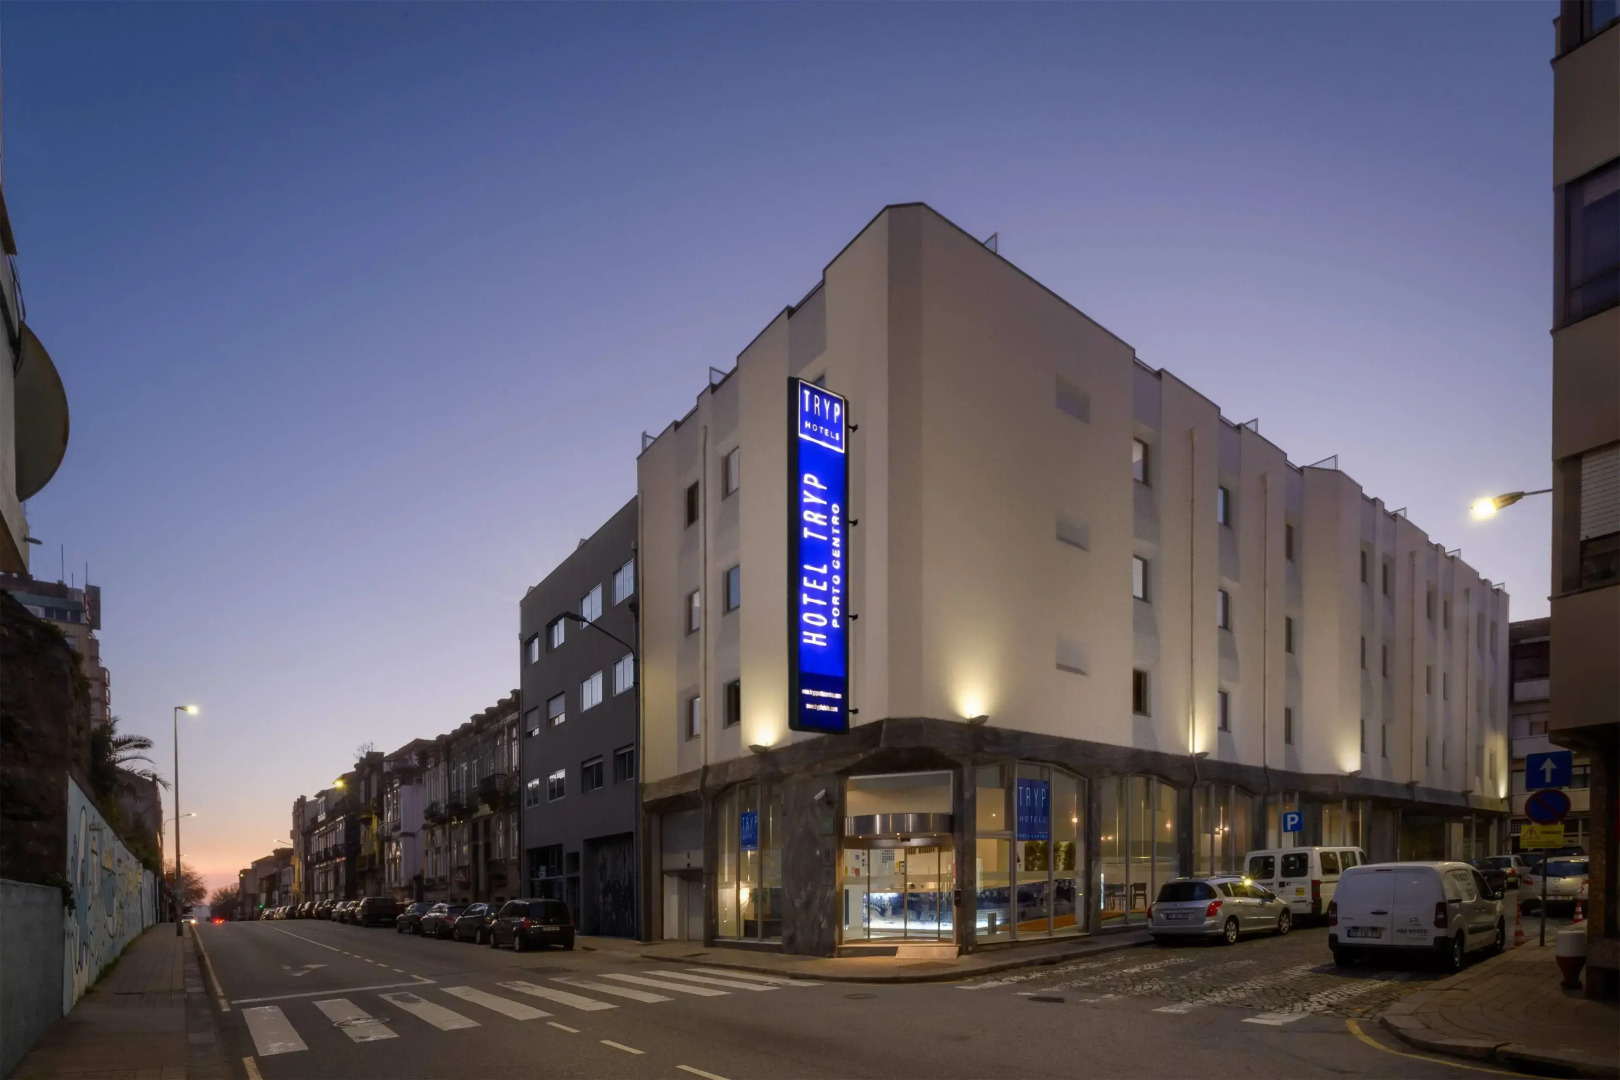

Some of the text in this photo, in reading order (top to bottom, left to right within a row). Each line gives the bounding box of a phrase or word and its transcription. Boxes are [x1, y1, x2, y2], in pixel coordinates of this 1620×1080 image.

[803, 389, 841, 424] TRYP
[804, 420, 840, 441] HOTELS
[802, 473, 828, 647] HOTEL TRYP
[831, 503, 841, 629] PORTO CENTRO
[1018, 786, 1047, 808] TRYP
[1286, 813, 1299, 831] P
